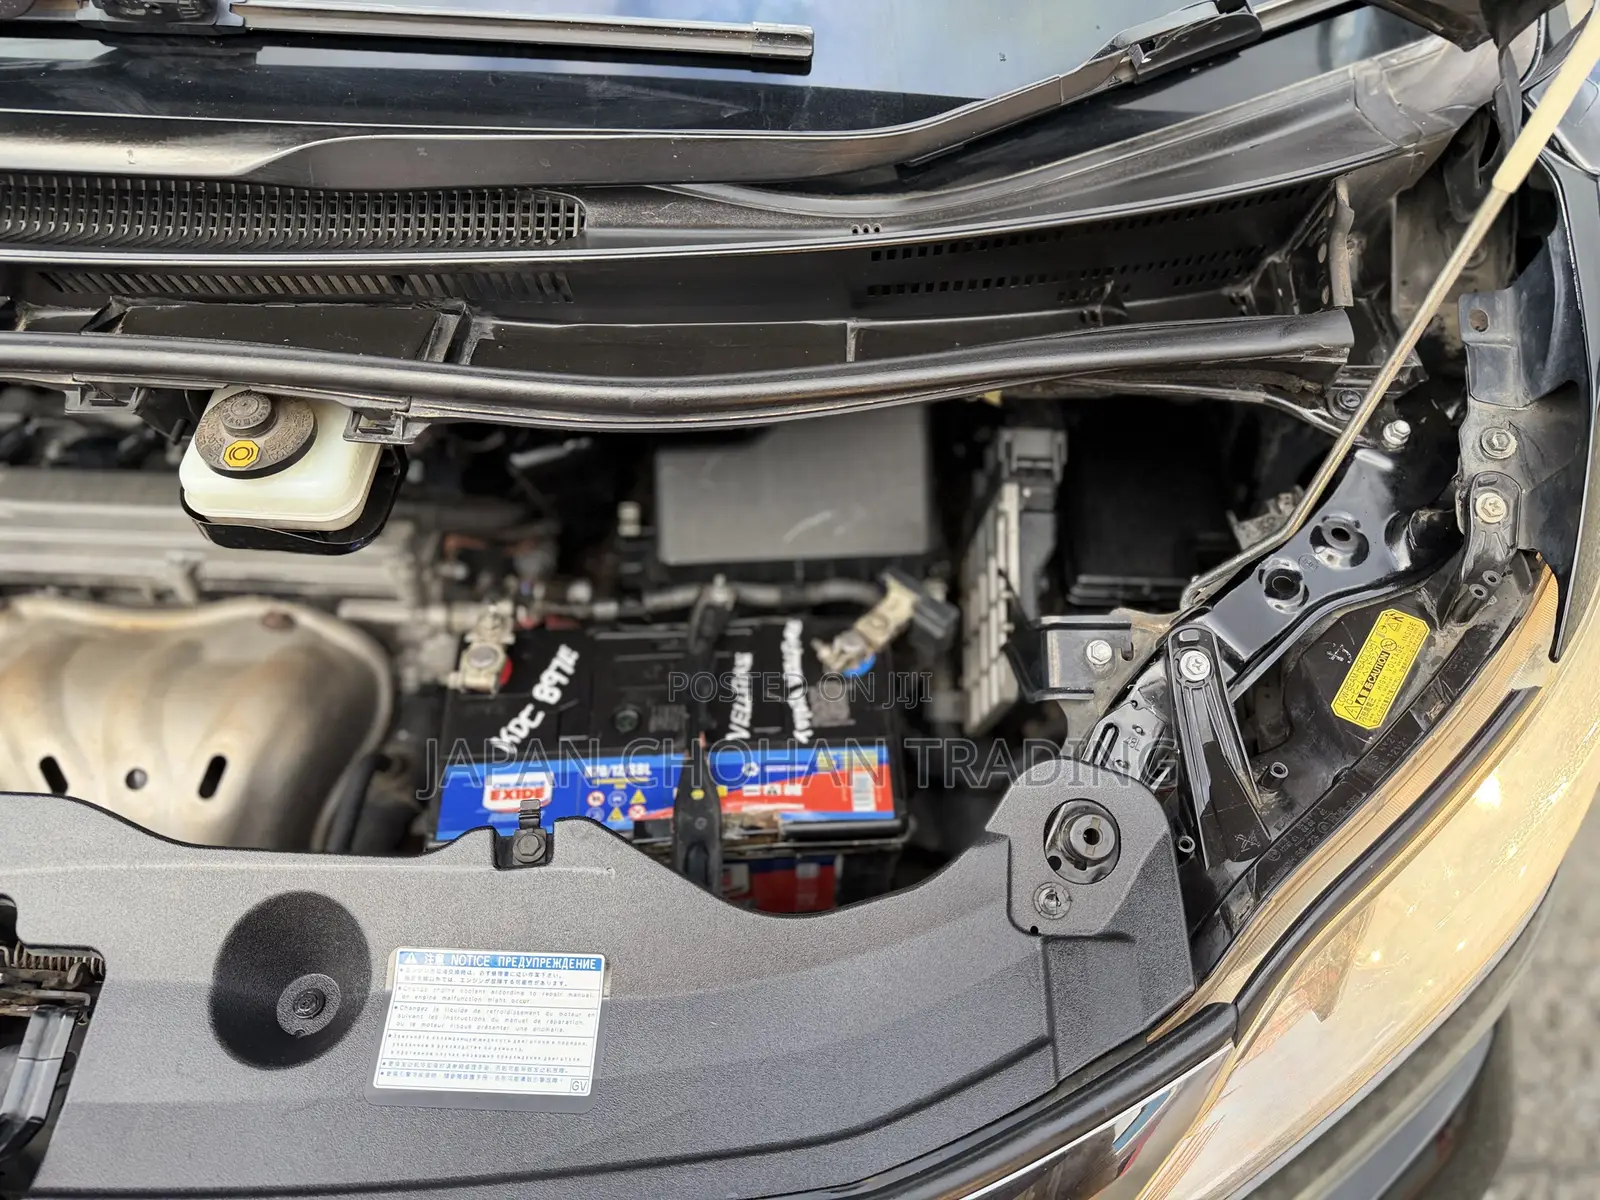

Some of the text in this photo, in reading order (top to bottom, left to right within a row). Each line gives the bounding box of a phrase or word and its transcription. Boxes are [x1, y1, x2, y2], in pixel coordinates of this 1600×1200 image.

[1354, 638, 1377, 673] HEADLIGHT
[1375, 673, 1388, 691] HIGH
[1385, 643, 1405, 672] VOLTAGE
[1400, 620, 1416, 642] INSIDE
[1367, 651, 1389, 683] CAUTION
[490, 787, 545, 801] EXIDE
[451, 954, 490, 967] NOTICE
[498, 956, 596, 970] ПРЕДУПРЕЖДЕНИЕ
[399, 1004, 428, 1012] Changez
[486, 1008, 540, 1016] refroidissement
[571, 1080, 588, 1091] GV
